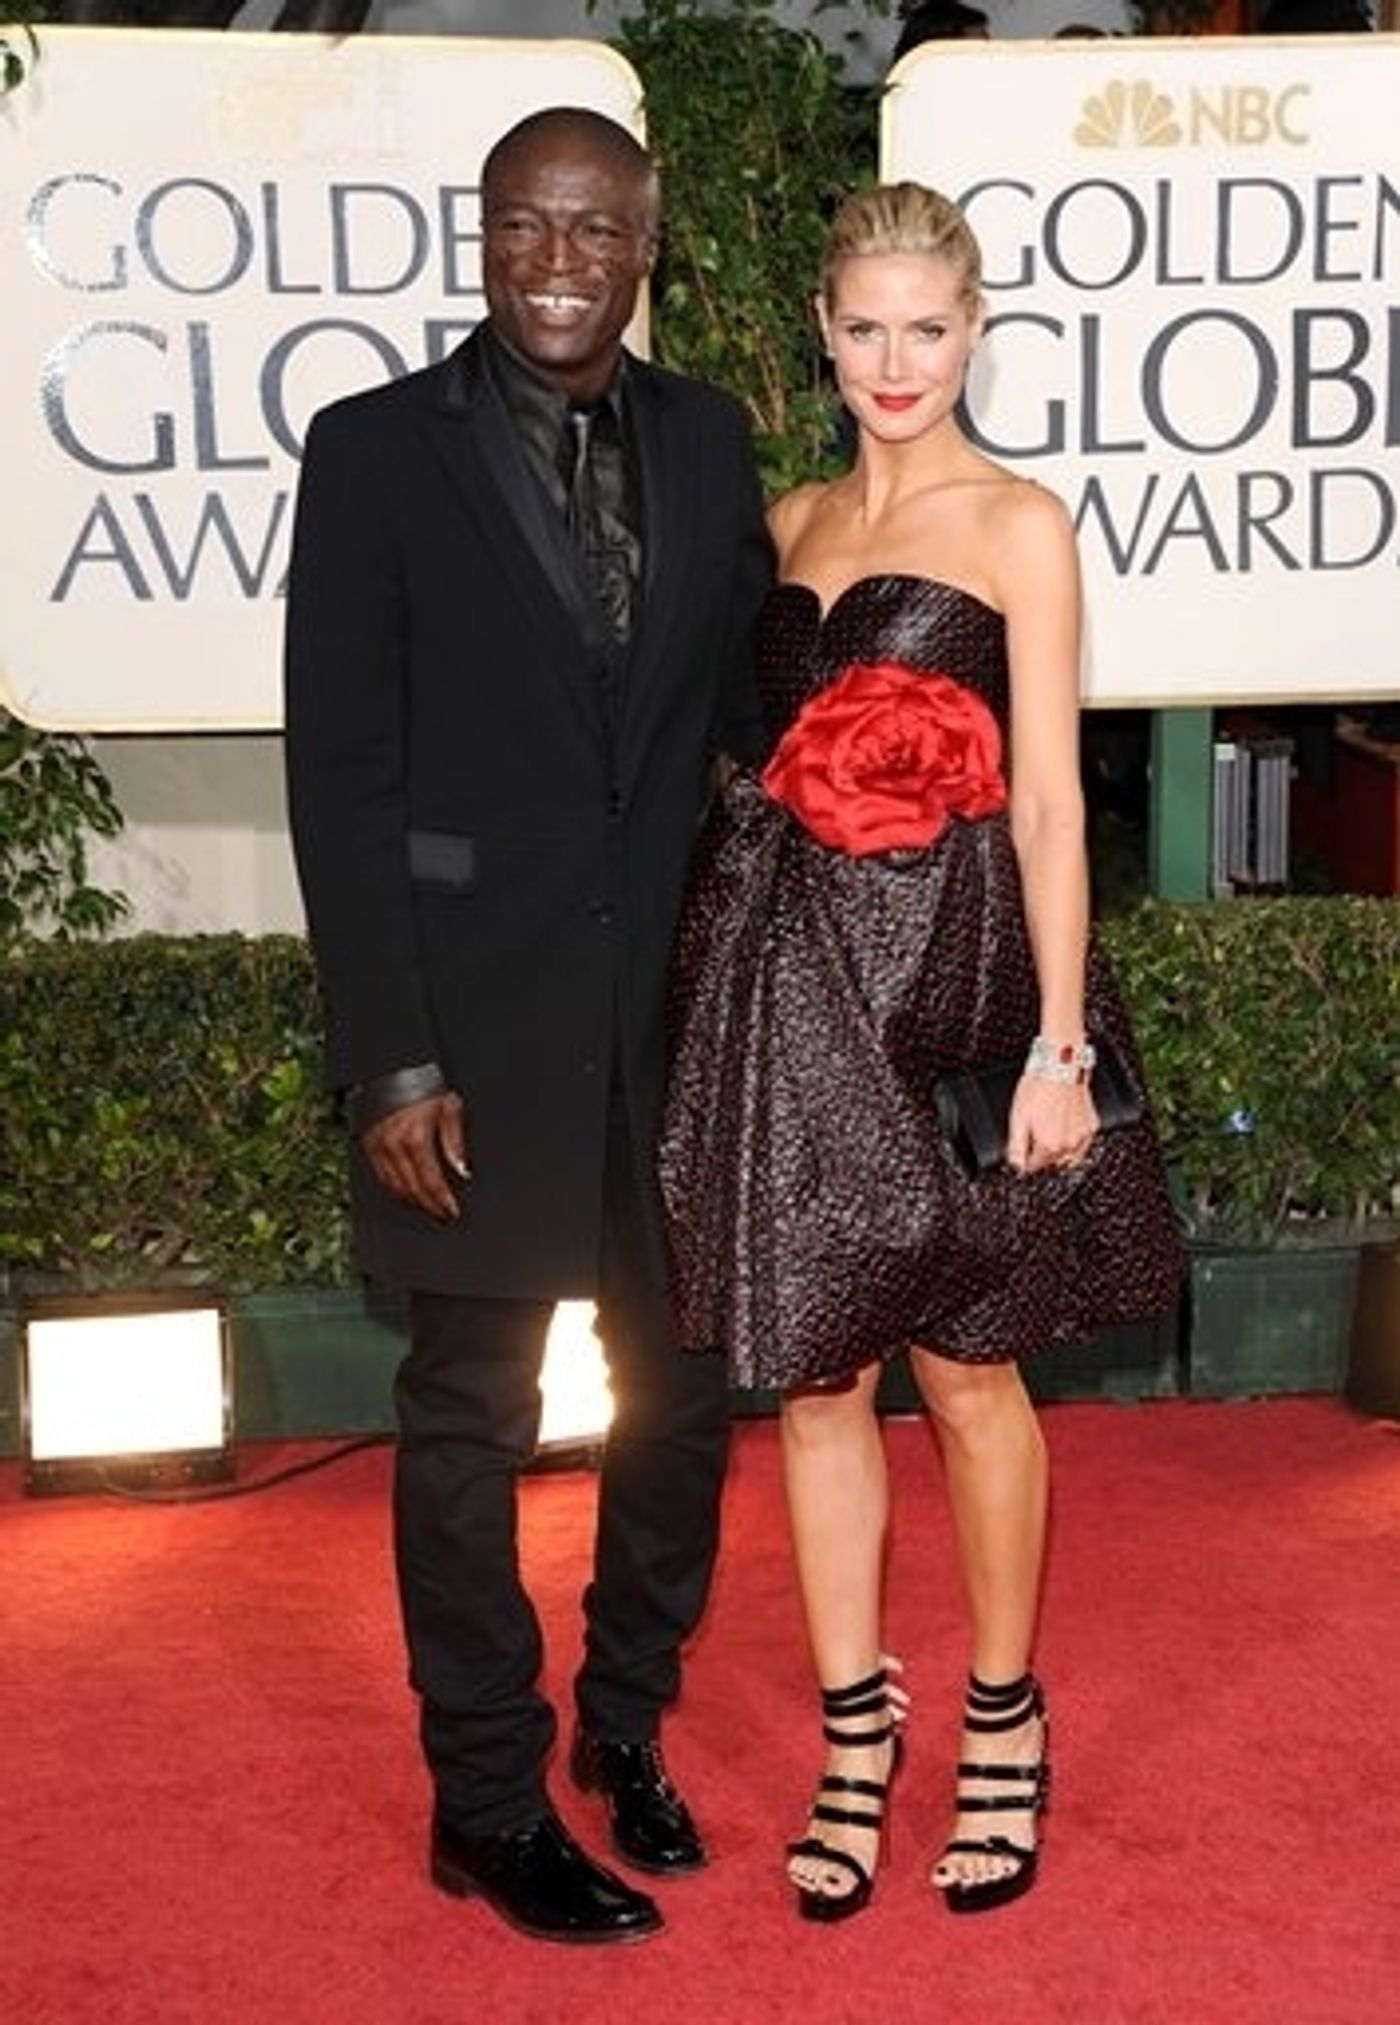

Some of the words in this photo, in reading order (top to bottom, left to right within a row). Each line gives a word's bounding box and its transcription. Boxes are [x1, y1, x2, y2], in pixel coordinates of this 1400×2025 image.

[1189, 83, 1312, 147] NBC
[41, 316, 480, 475] GLO
[953, 309, 1400, 458] GLOB
[50, 490, 290, 601] AW
[1075, 468, 1400, 577] WARD
